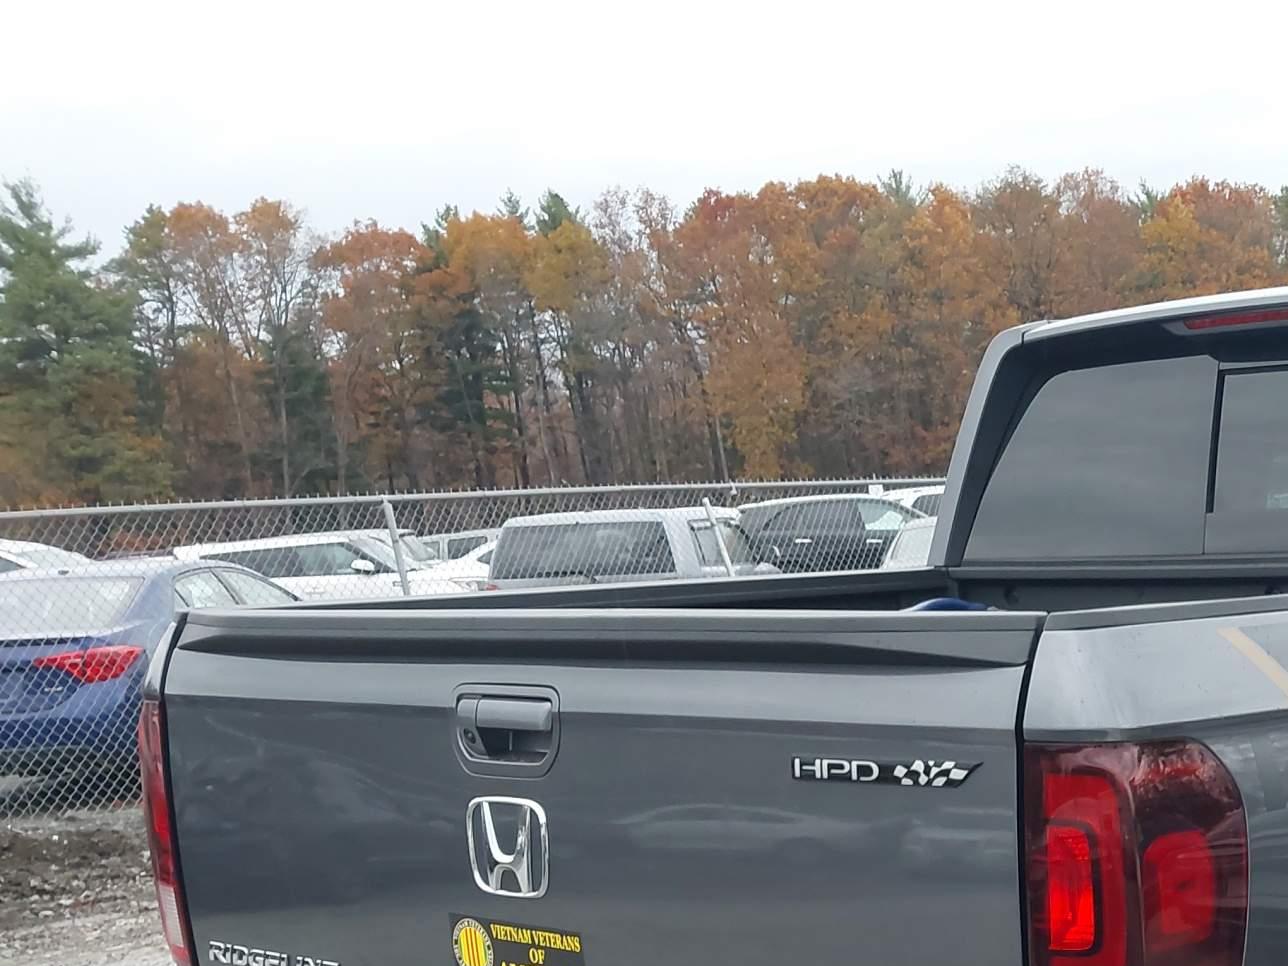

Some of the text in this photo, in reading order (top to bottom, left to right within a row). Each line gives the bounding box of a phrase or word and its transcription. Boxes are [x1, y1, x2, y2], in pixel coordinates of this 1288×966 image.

[794, 757, 880, 782] HPD
[489, 923, 581, 953] VIETNAM VETERANS
[529, 947, 545, 965] OF
